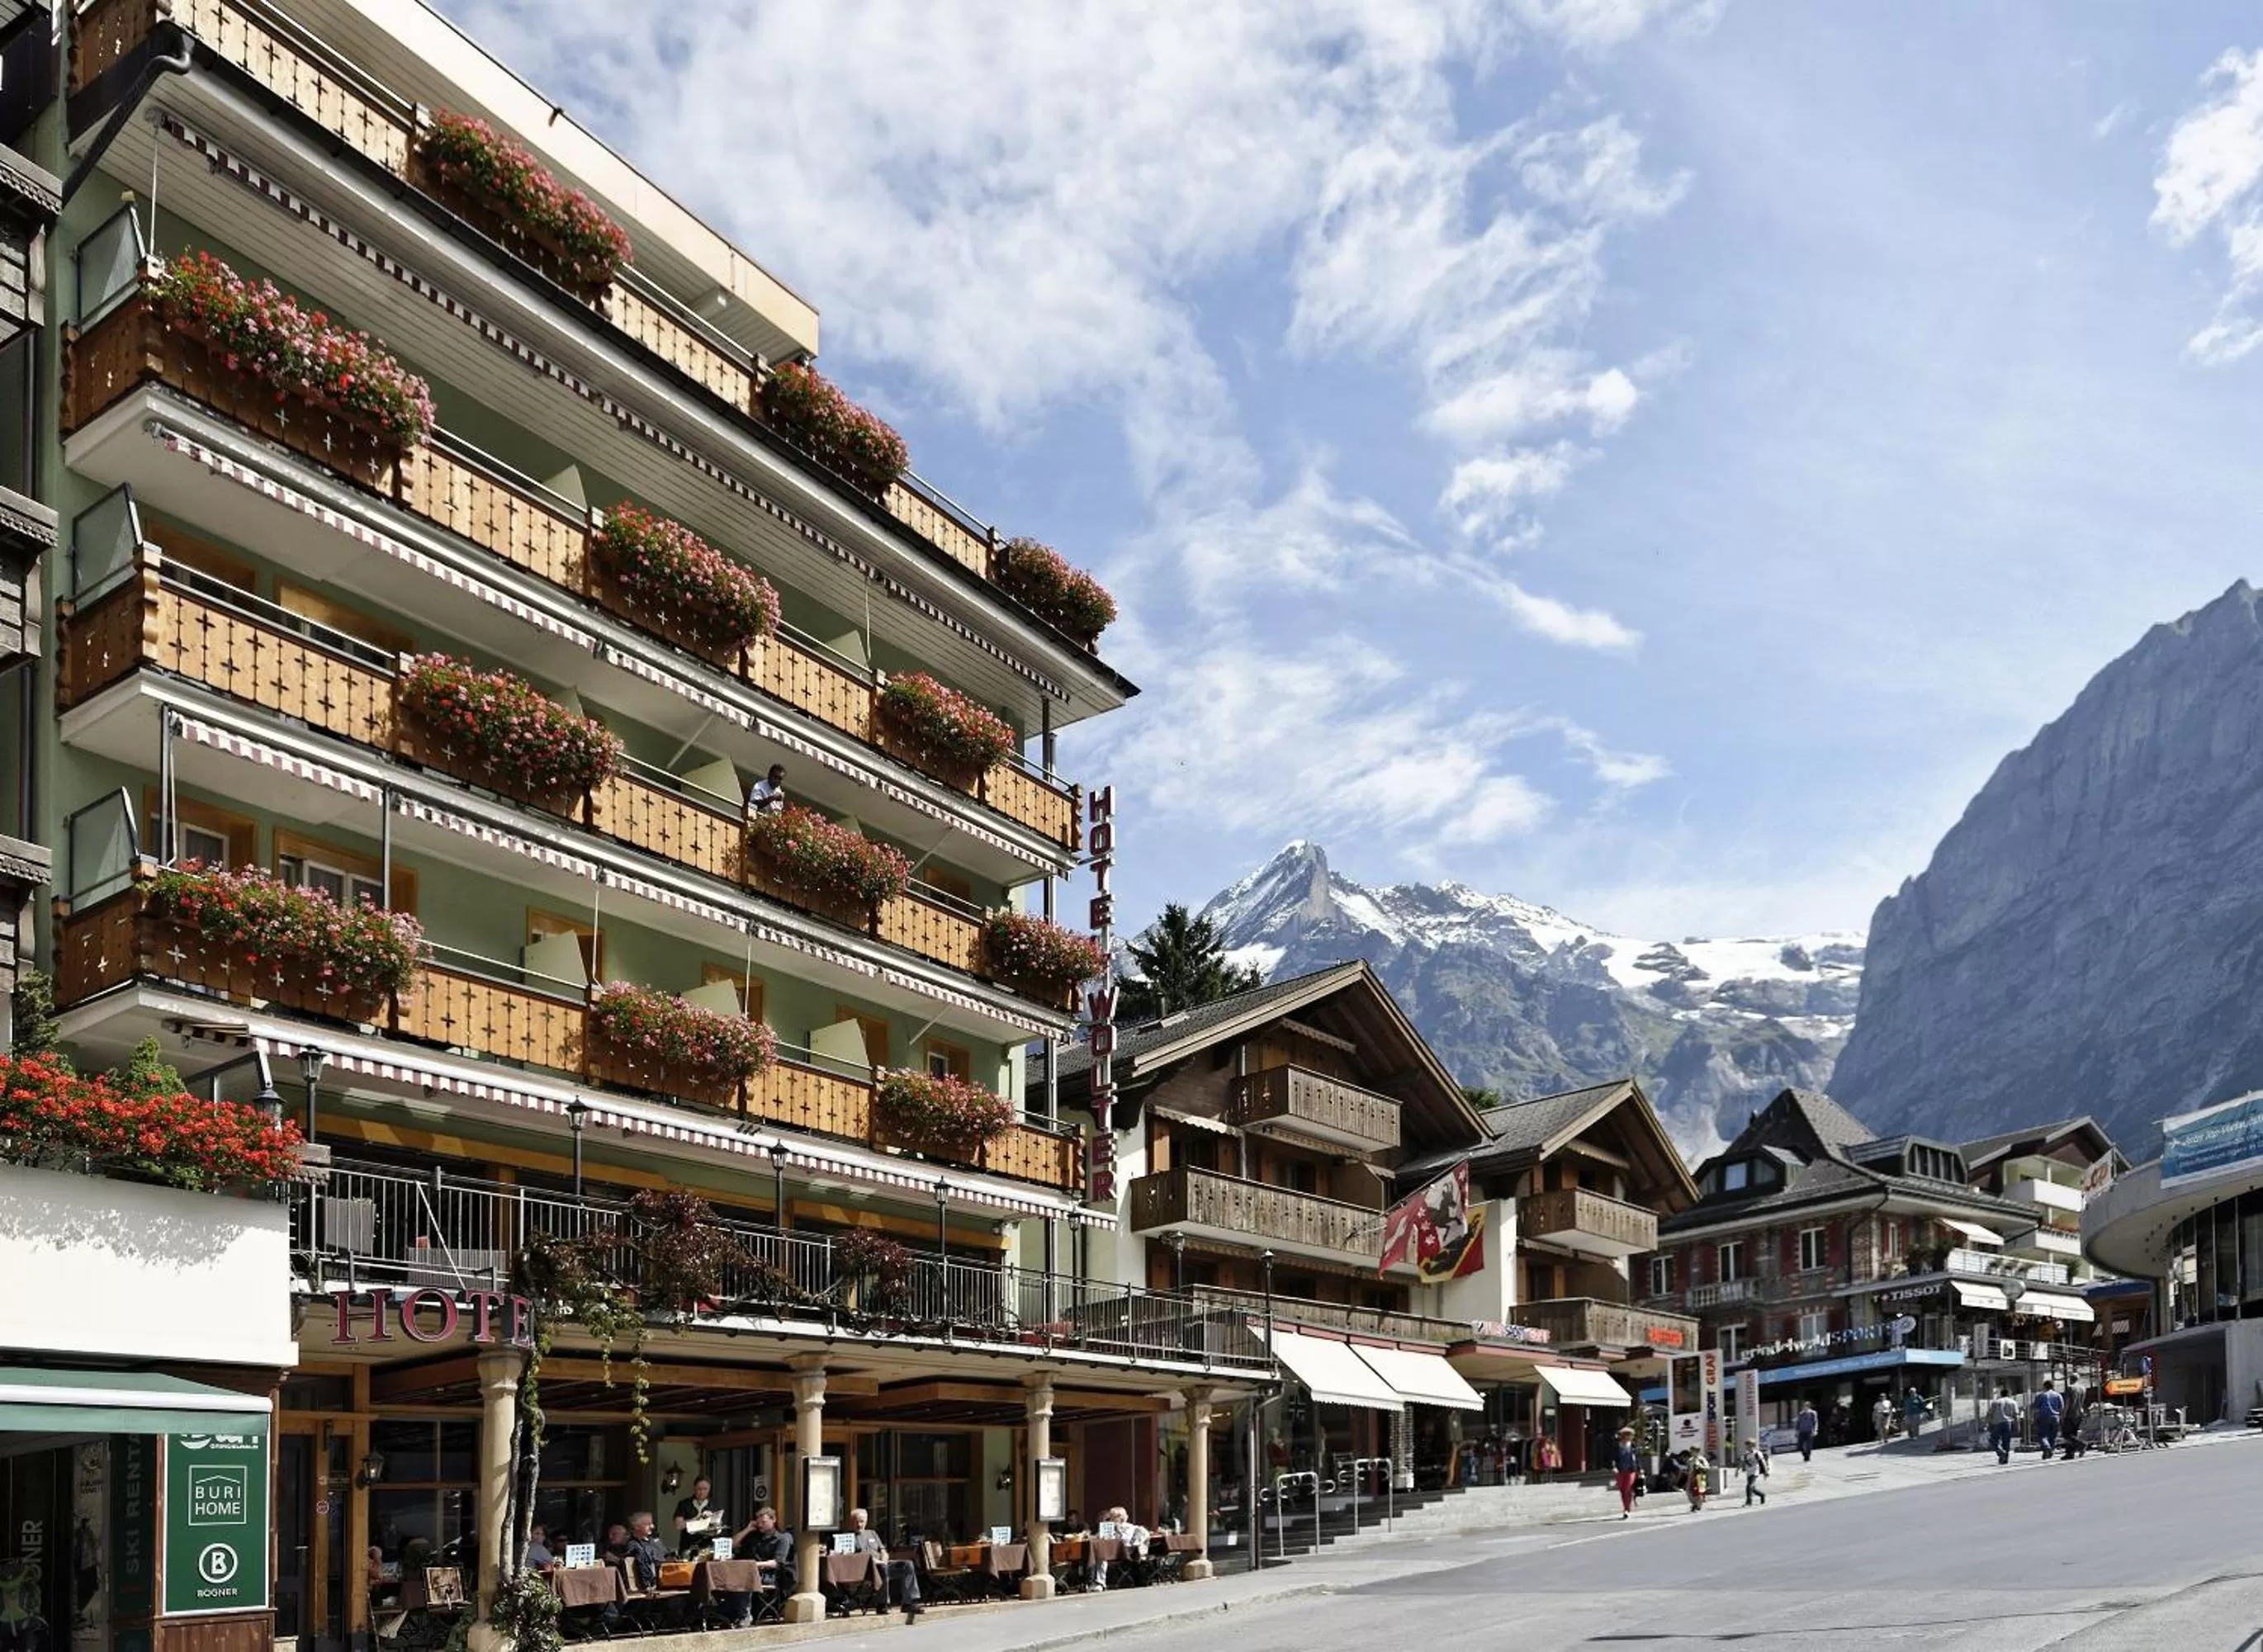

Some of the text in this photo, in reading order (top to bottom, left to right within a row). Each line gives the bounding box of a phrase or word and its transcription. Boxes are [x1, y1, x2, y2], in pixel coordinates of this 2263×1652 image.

[1088, 784, 1115, 960] HOTE
[1087, 986, 1120, 1201] WOLTER
[1891, 1283, 1942, 1301] TISSOT
[329, 1286, 536, 1349] HOTE
[125, 1435, 141, 1575] SKI RENTA
[195, 1485, 241, 1499] BURI
[195, 1502, 241, 1516] HOME
[196, 1588, 238, 1598] BOGNER
